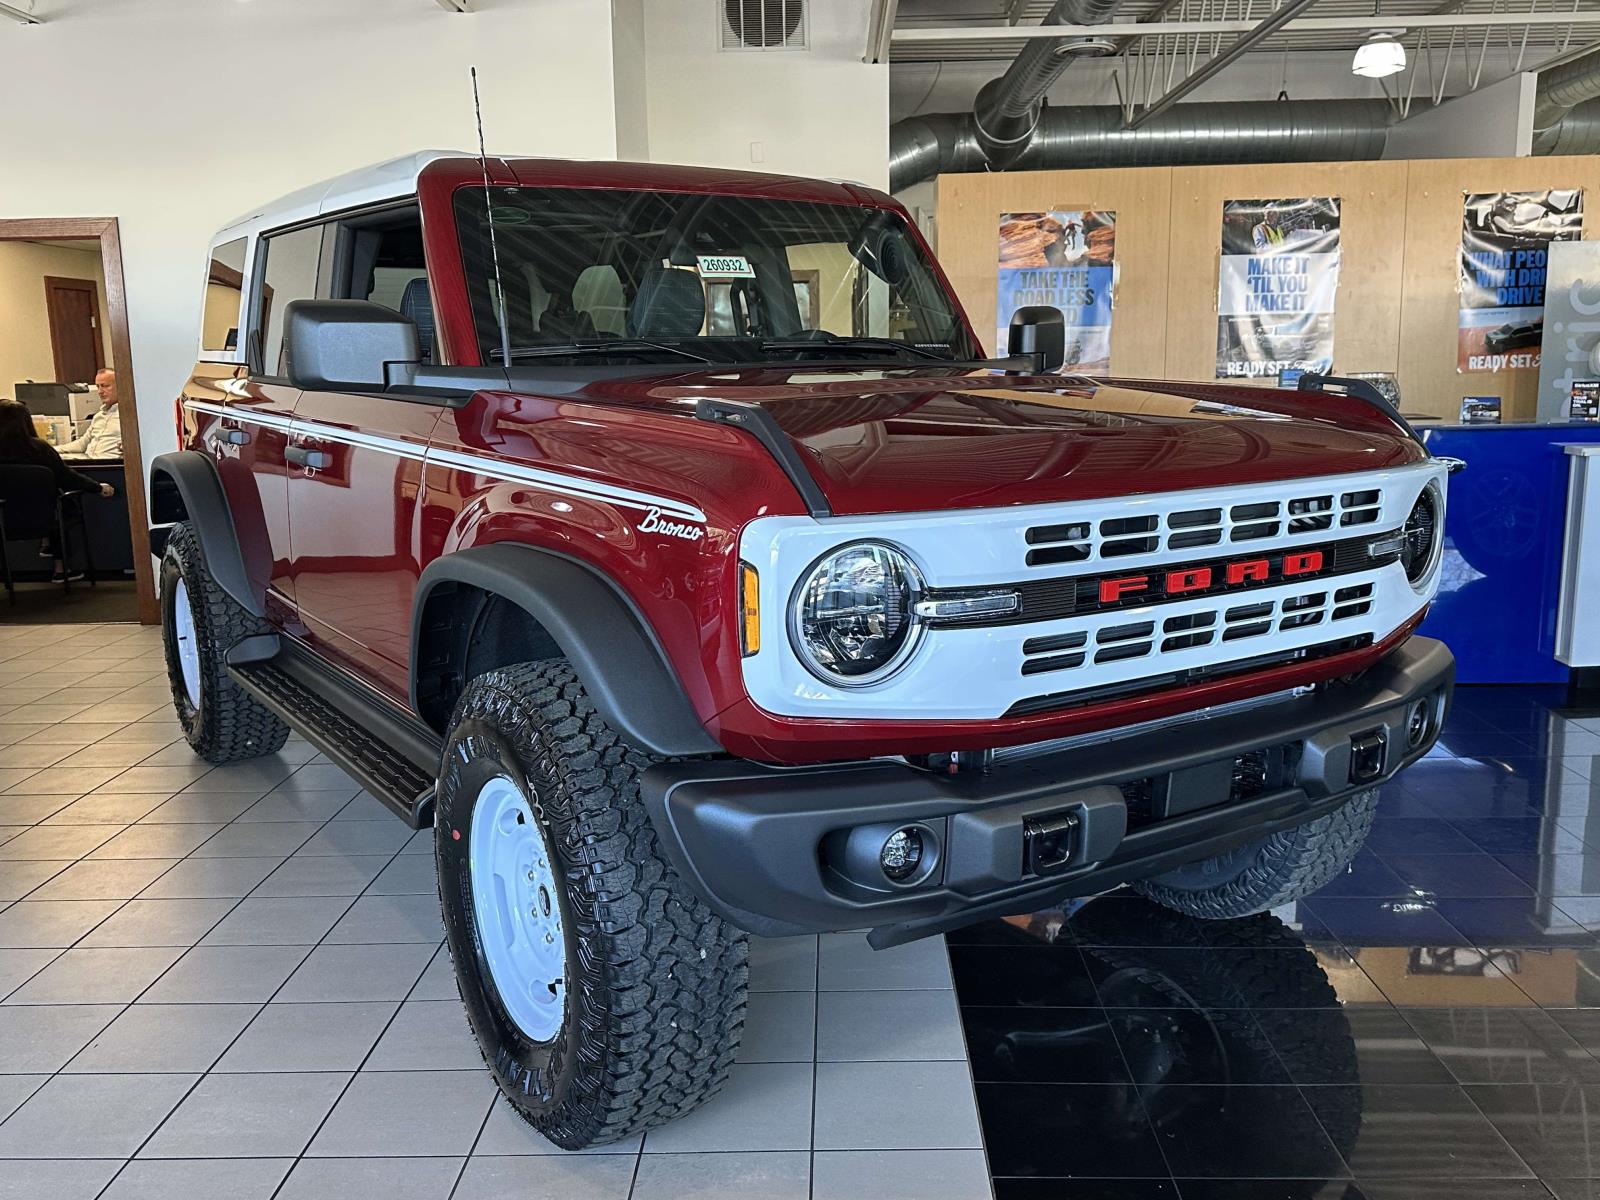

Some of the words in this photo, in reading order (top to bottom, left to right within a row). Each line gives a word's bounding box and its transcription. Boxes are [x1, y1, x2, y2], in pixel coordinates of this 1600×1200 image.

[703, 259, 745, 271] 260932
[1247, 257, 1293, 275] MAKE
[1296, 257, 1309, 274] IT
[1470, 250, 1514, 270] WHAT
[1515, 249, 1547, 268] PEO
[1021, 271, 1057, 288] TAKE
[1061, 270, 1089, 288] THE
[1277, 276, 1309, 293] YOU
[1475, 269, 1517, 288] WITH
[1518, 268, 1546, 286] DRI
[1013, 290, 1056, 305] ROAD
[1058, 288, 1095, 305] LESS
[1245, 294, 1291, 312] MAKE
[1293, 294, 1308, 311] IT
[1496, 287, 1544, 305] DRIVE
[1226, 360, 1267, 376] READY
[1468, 355, 1509, 370] READY
[1509, 354, 1533, 369] SET
[637, 505, 704, 541] Bronco
[1100, 551, 1323, 603] FORD
